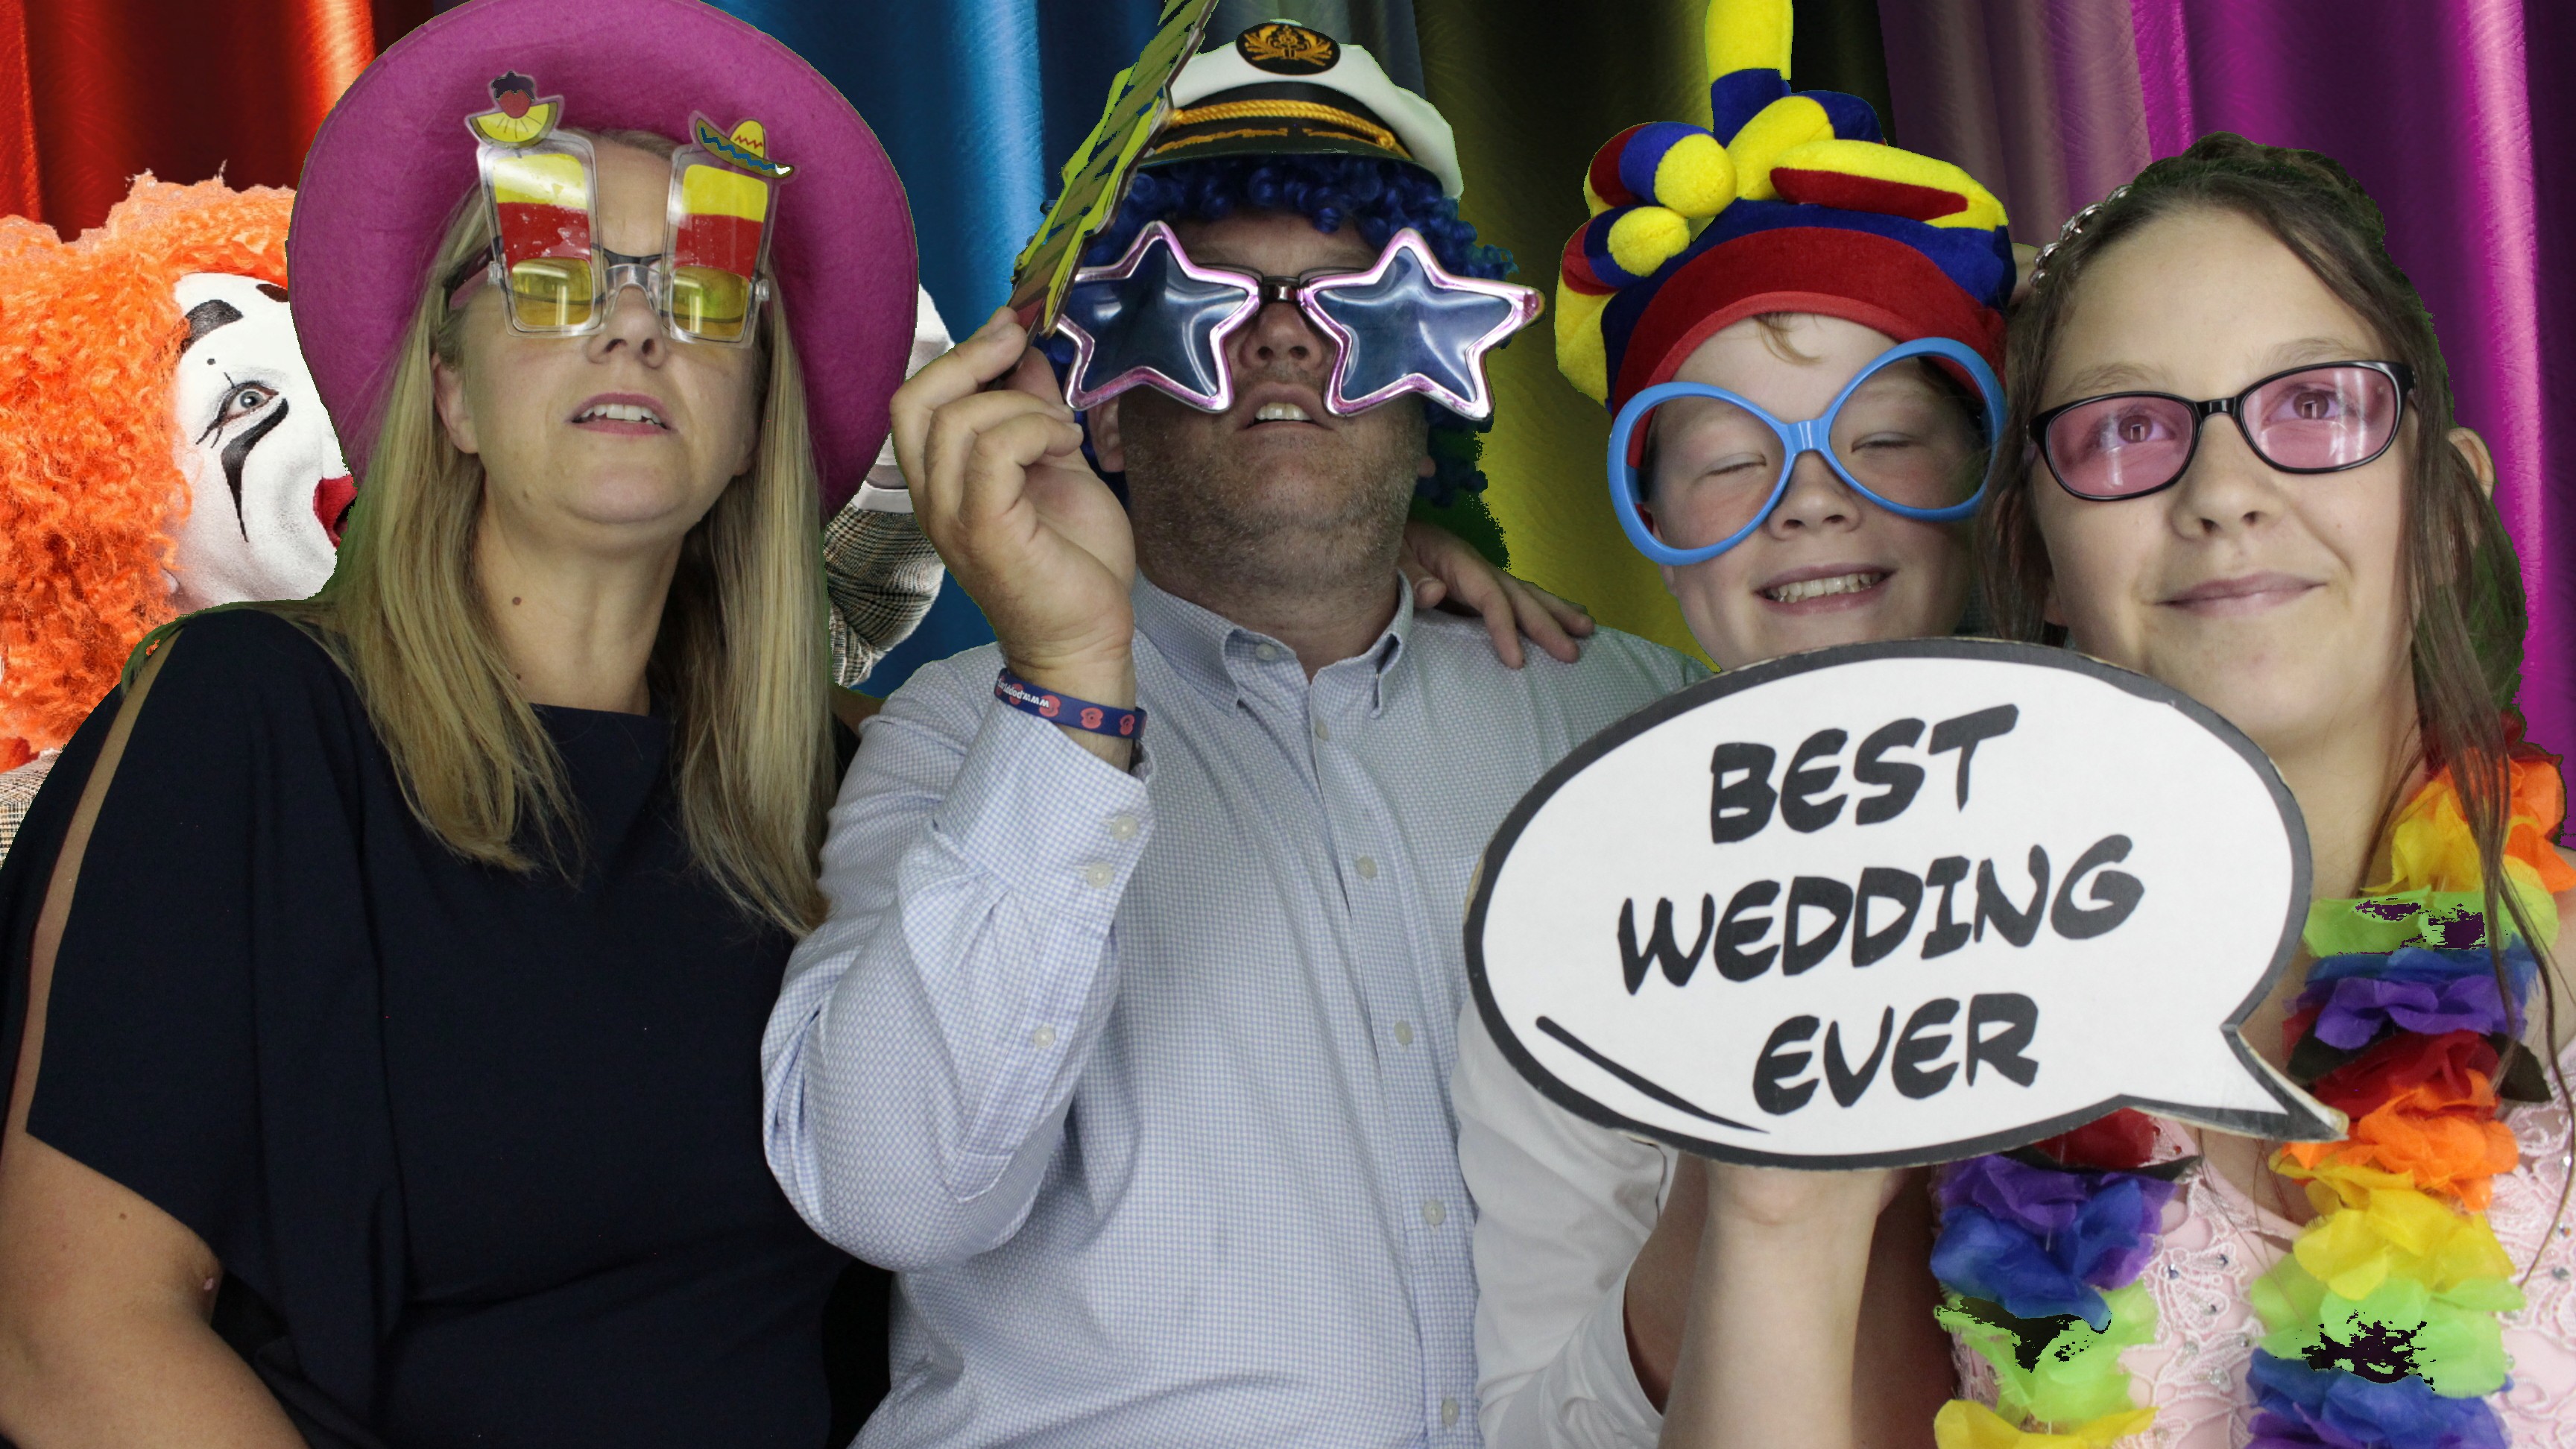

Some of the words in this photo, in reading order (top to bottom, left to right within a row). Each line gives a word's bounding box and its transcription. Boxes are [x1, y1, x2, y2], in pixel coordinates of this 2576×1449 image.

[1710, 704, 2019, 845] BEST
[1617, 834, 2144, 996] WEDDING
[1752, 992, 2039, 1116] EVER
